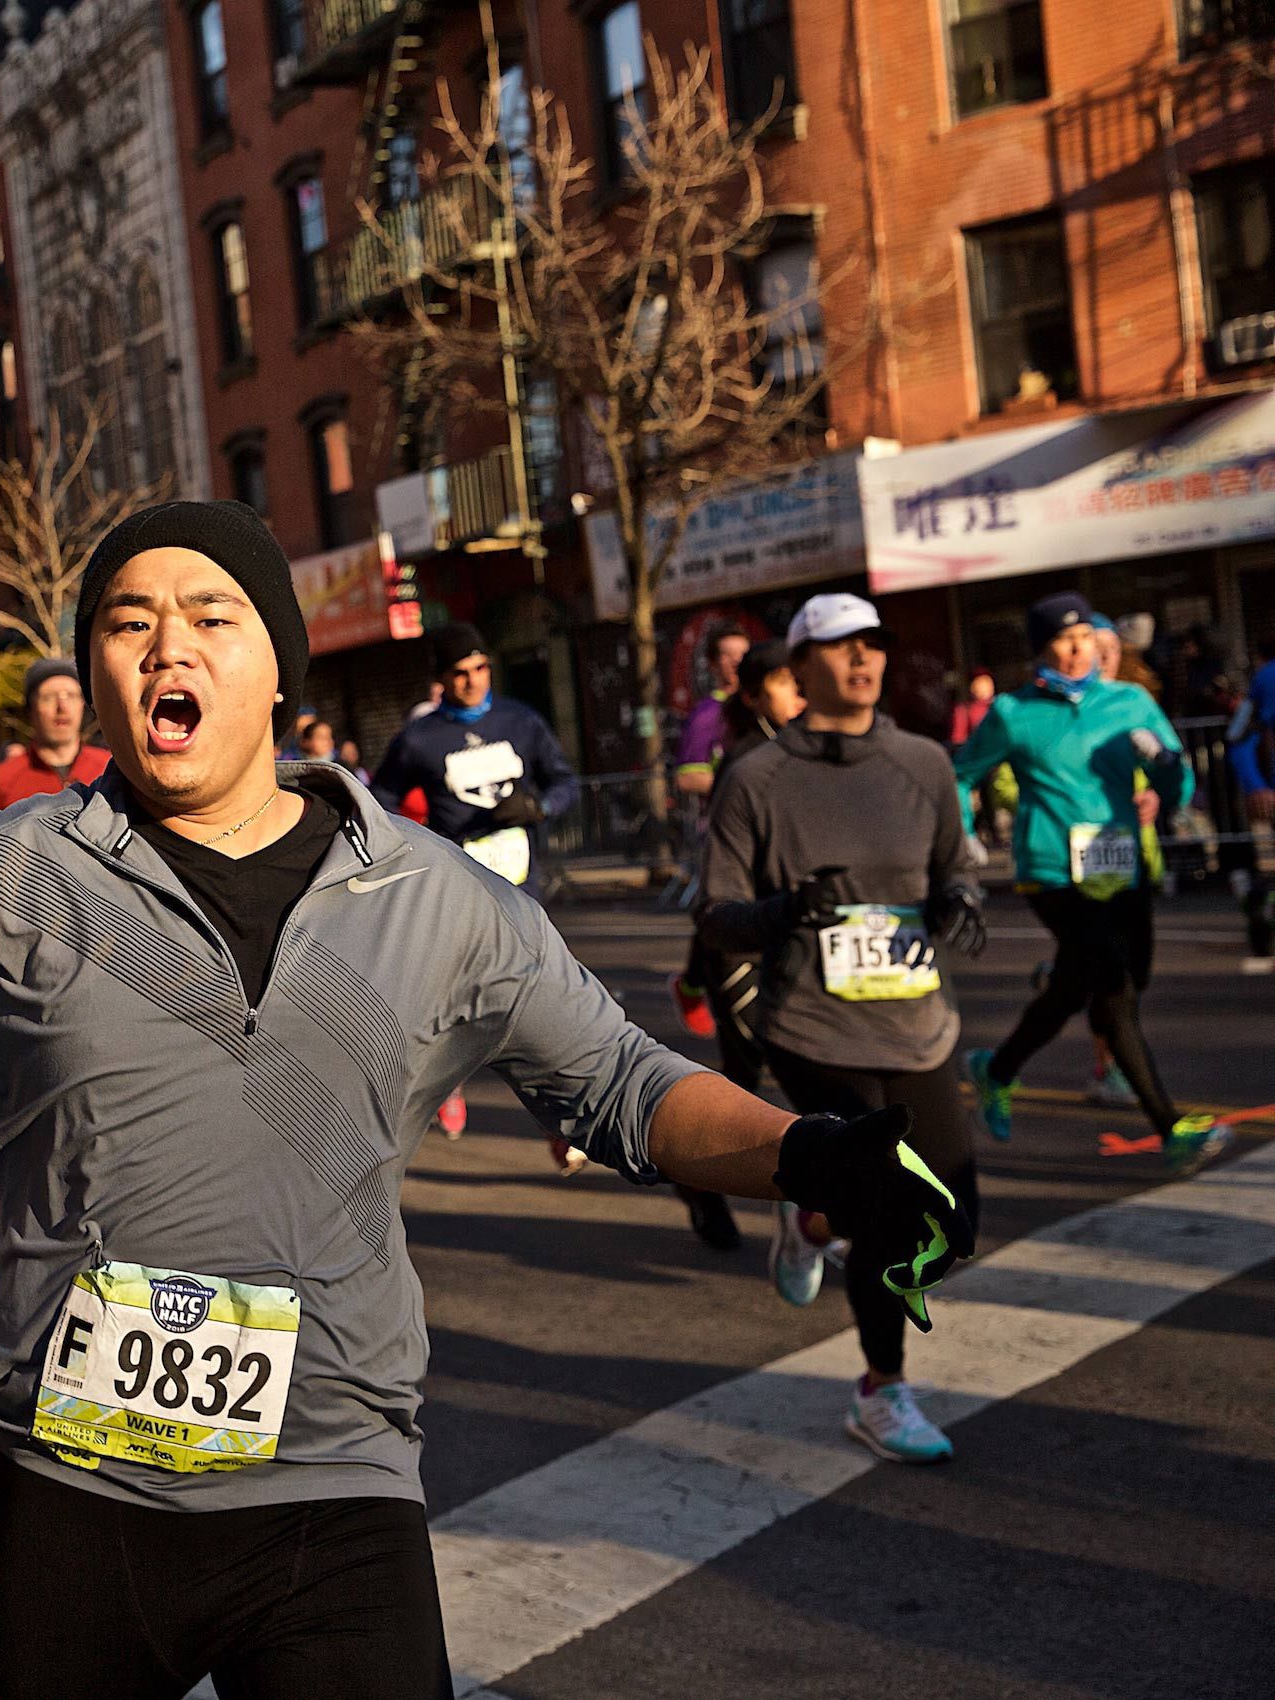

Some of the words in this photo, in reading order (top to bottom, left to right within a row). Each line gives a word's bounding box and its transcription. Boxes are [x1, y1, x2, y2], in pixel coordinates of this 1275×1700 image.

[830, 934, 840, 955] F
[158, 1291, 202, 1313] NYC
[159, 1309, 196, 1325] HALF
[58, 1315, 94, 1369] F
[114, 1330, 271, 1423] 9832
[47, 1426, 90, 1441] AIRLINES
[56, 1422, 91, 1434] UNITED
[126, 1414, 177, 1439] WAVE
[181, 1428, 189, 1441] 1
